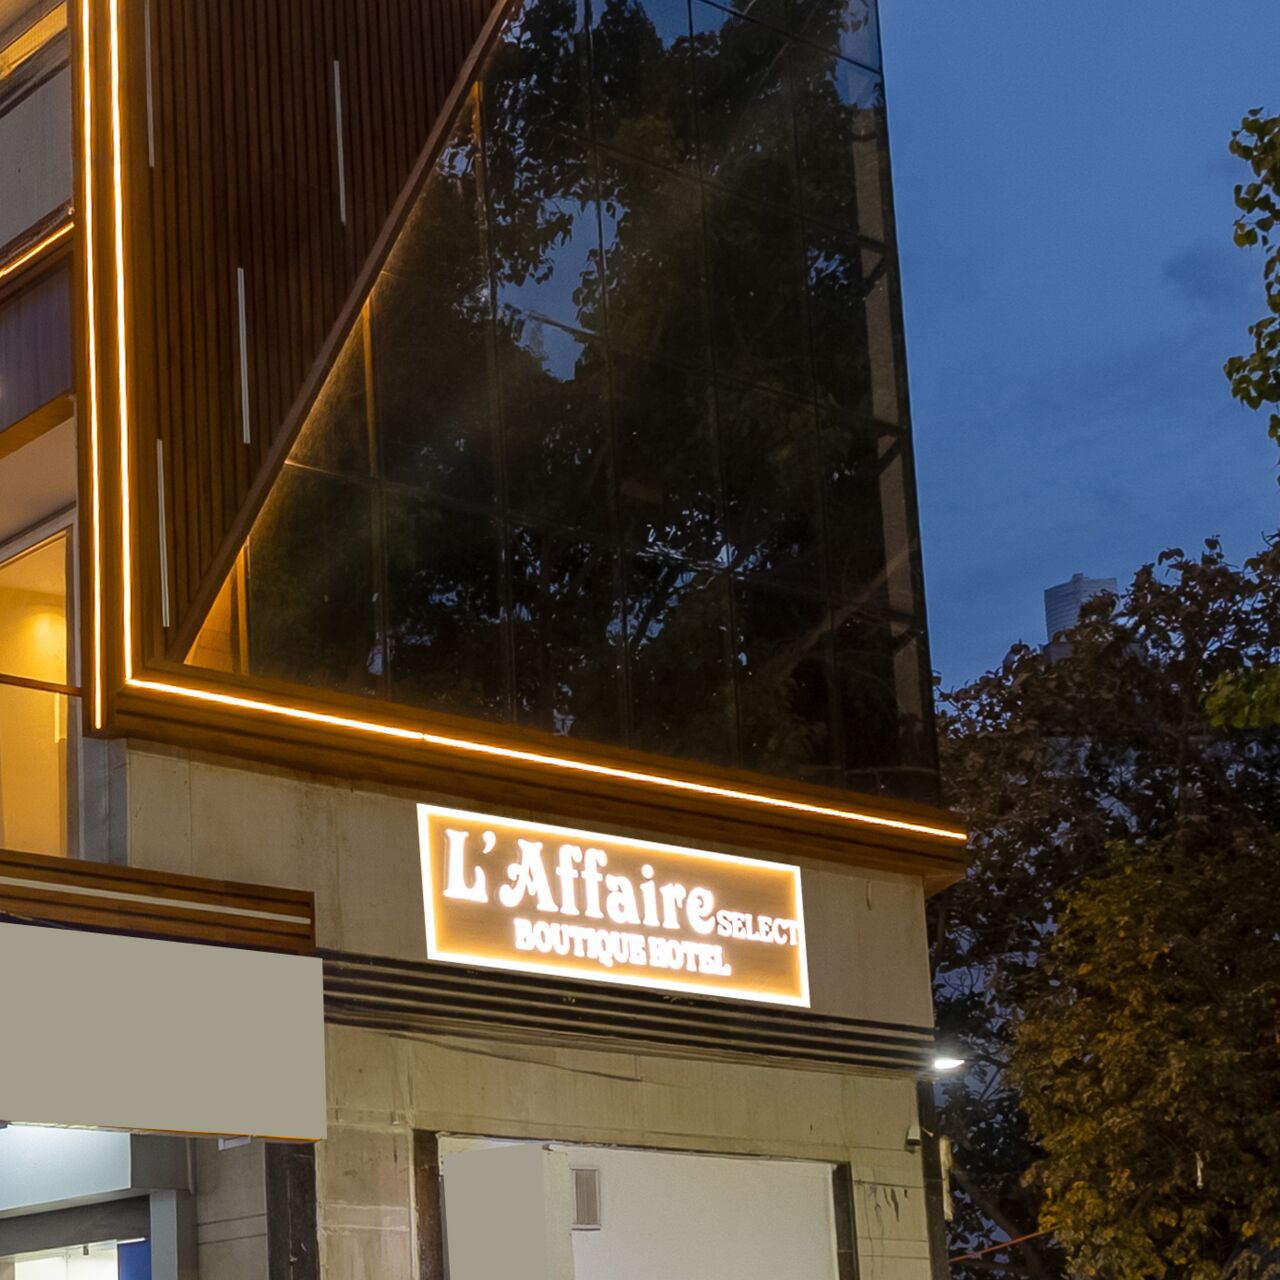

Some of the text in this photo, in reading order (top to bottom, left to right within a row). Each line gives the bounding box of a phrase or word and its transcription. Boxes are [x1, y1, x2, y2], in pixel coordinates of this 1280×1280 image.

[443, 827, 801, 946] L'Affaire SELECT
[514, 917, 732, 976] BOUTIQUE HOTEL
